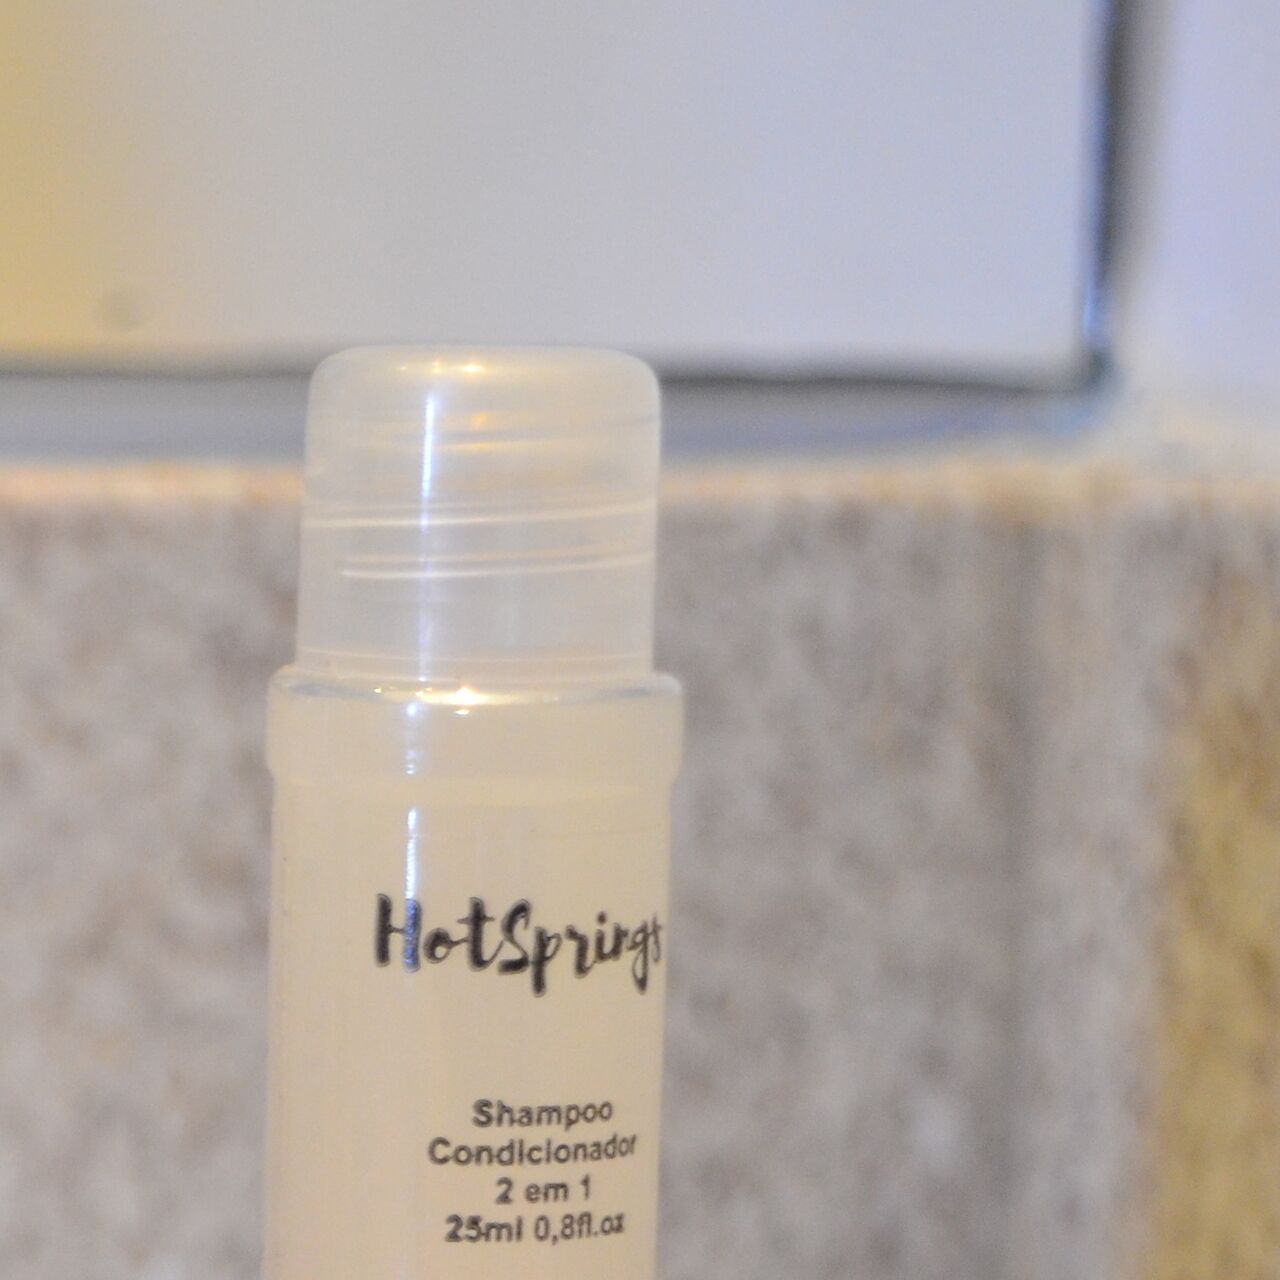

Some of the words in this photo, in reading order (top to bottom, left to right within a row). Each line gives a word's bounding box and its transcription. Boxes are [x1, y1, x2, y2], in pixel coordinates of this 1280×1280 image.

[471, 1099, 614, 1131] Shampoo
[428, 1134, 637, 1166] Condicionador
[494, 1176, 513, 1205] 2
[524, 1183, 569, 1204] em
[580, 1173, 592, 1200] 1
[445, 1213, 523, 1243] 25ml
